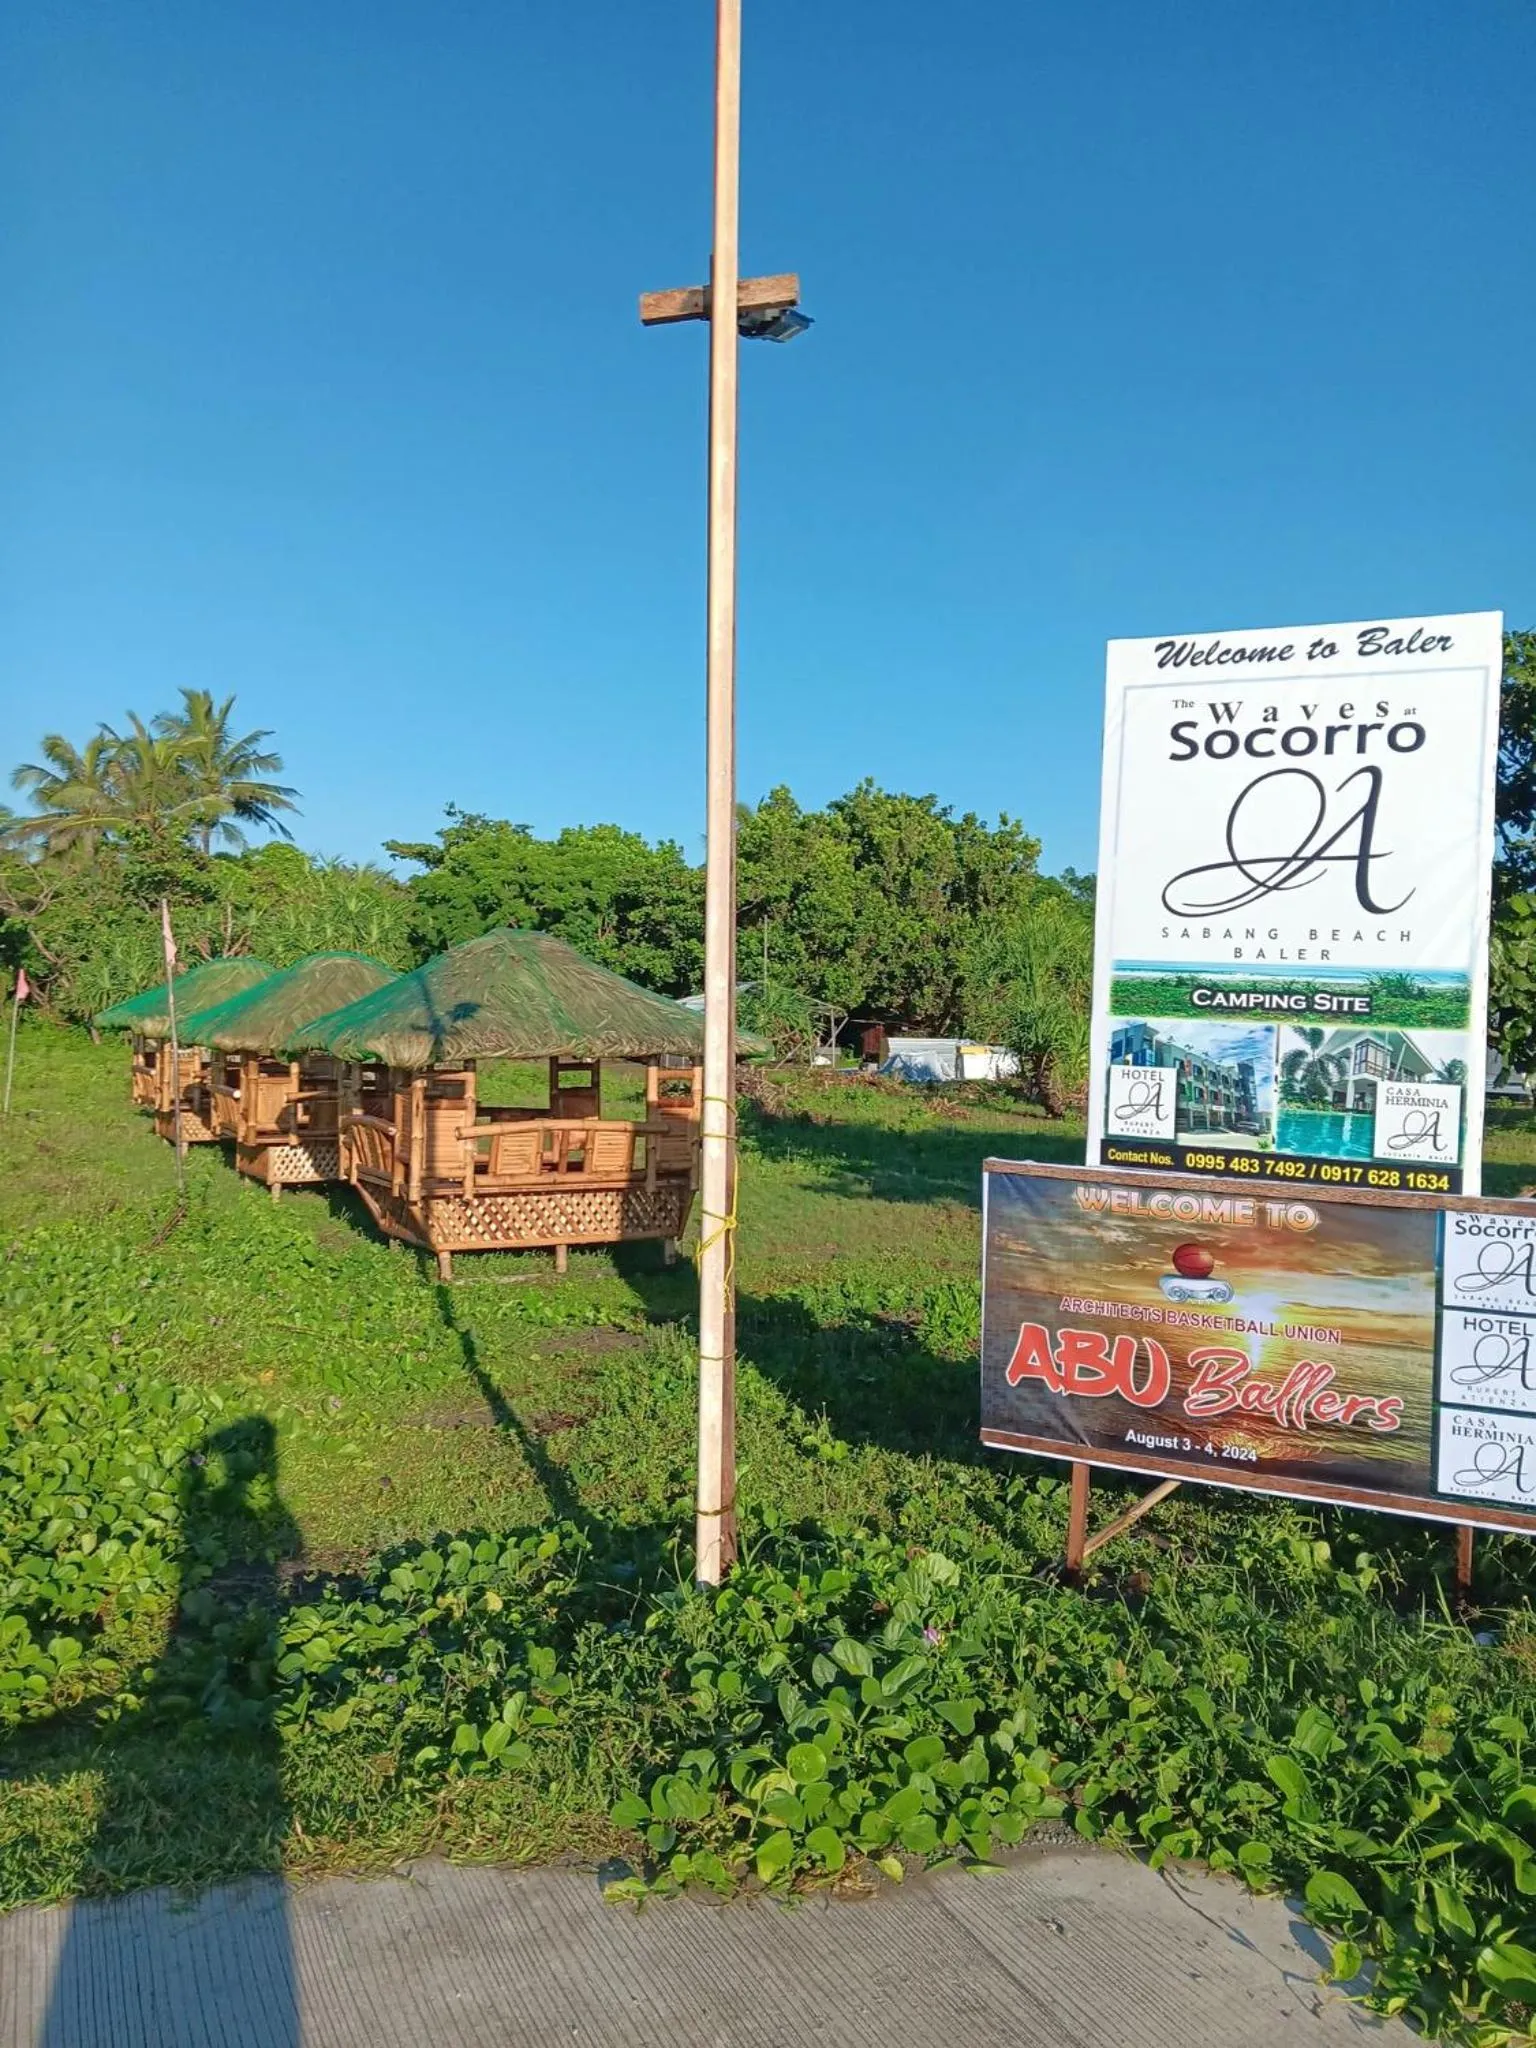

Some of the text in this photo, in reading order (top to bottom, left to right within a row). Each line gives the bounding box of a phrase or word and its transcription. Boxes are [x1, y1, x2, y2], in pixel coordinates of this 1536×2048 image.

[1154, 626, 1455, 669] Welcome to Baler
[1172, 699, 1417, 725] The Waves at
[1168, 720, 1427, 762] Socorro
[1161, 928, 1411, 942] SABANG BEACH
[1234, 947, 1331, 961] BALER
[1192, 989, 1371, 1013] CAMPING SITE
[1121, 1069, 1165, 1082] HOTEL
[1385, 1095, 1449, 1109] HERMINIA
[1386, 1087, 1421, 1097] CASA
[1107, 1148, 1450, 1191] Contact Nos. 0995 483 7492 / 0917 628 1634
[1075, 1186, 1319, 1233] WELCOME TO
[1455, 1219, 1536, 1240] Socorr
[1060, 1296, 1343, 1345] ARCHITECTS BASKETBALL UNION
[1463, 1316, 1535, 1337] HOTEL
[1005, 1322, 1405, 1432] ABU Ballers
[1453, 1415, 1498, 1429] CASA
[1125, 1428, 1179, 1449] August
[1182, 1438, 1191, 1451] 3
[1204, 1442, 1218, 1458] 4,
[1221, 1445, 1258, 1462] 2024
[1452, 1425, 1535, 1446] HERMINIA
